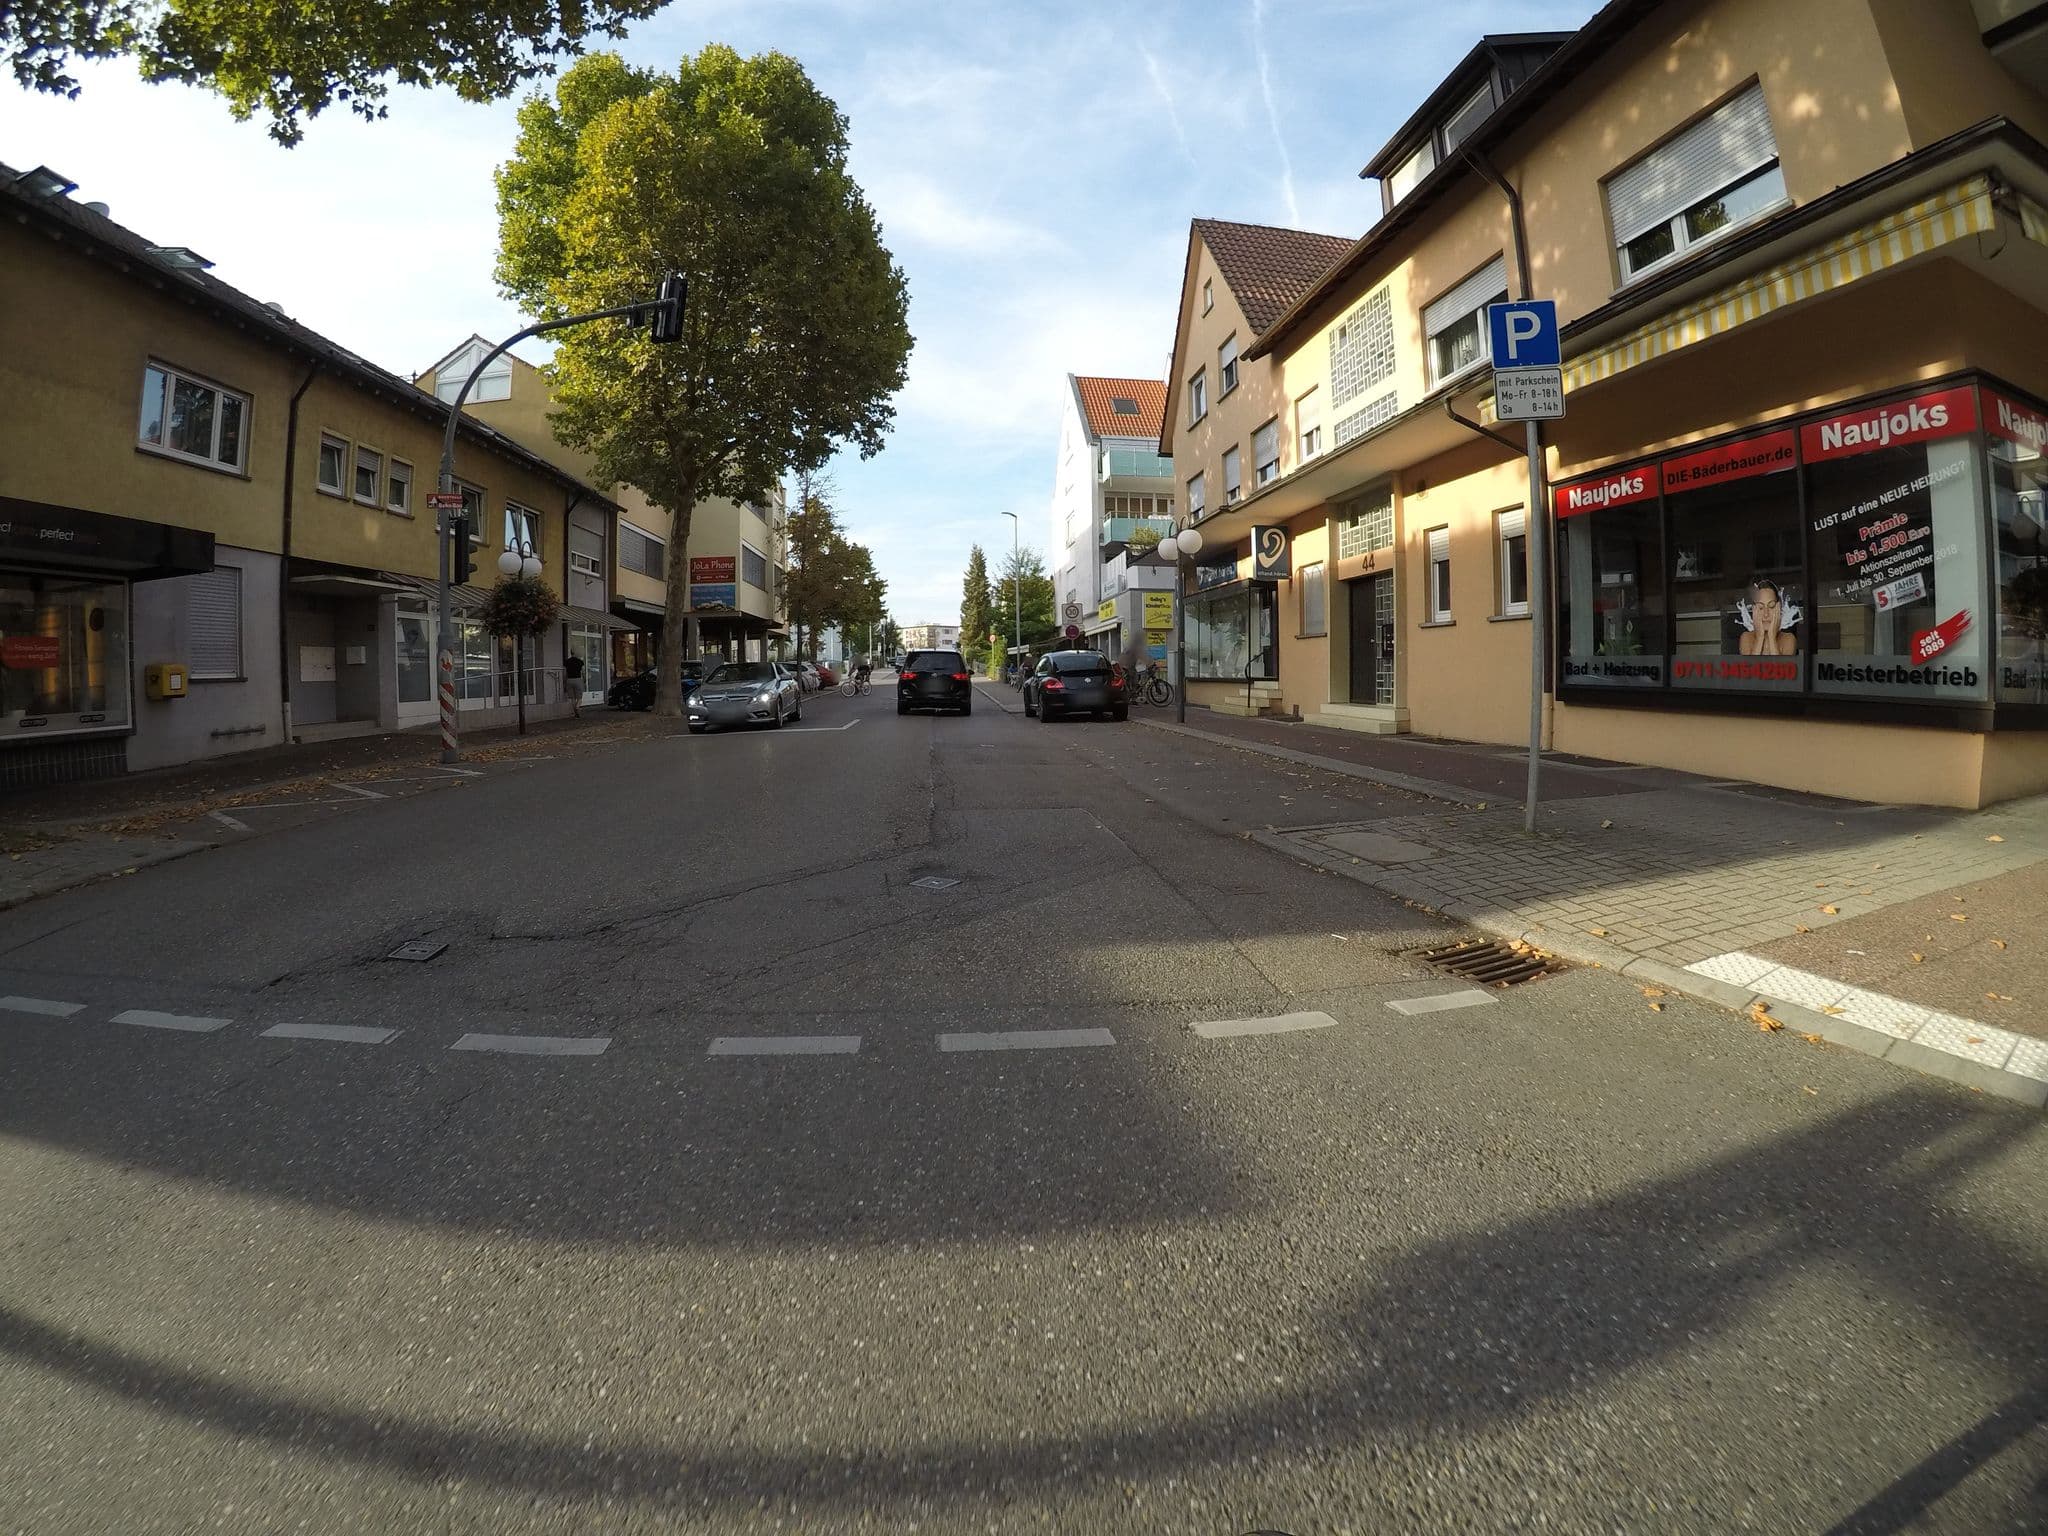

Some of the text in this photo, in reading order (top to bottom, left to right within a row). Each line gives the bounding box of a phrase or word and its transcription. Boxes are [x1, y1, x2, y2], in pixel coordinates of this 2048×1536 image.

[1505, 311, 1540, 359] P
[1499, 375, 1558, 387] mit Parkschein
[1502, 389, 1527, 400] Mo-Fr
[1503, 404, 1512, 414] Sa
[1821, 404, 1949, 450] Naujoks
[1997, 399, 2048, 449] Naujo
[1667, 447, 1793, 485] DIE-Bäderbauer.de
[1568, 476, 1644, 508] Naujoks
[1814, 460, 1965, 531] LUST auf eine NEUE HEIZUNG?
[40, 526, 74, 541] perfect
[1859, 512, 1908, 541] Prämie
[1362, 553, 1375, 571] 44
[1845, 550, 1867, 566] bis
[1869, 531, 1908, 556] 1.500
[1860, 544, 1925, 575] Aktionszeitraum
[711, 560, 734, 569] Phone
[1845, 581, 1859, 593] Juli
[1859, 577, 1872, 588] bis
[1873, 571, 1887, 583] 30.
[1887, 554, 1934, 578] September
[1935, 543, 1958, 560] 2018
[1877, 591, 1889, 608] 5
[1894, 575, 1919, 592] JAHRE
[1919, 630, 1940, 647] seit
[1919, 638, 1945, 657] 1989
[1565, 662, 1587, 676] Bad
[1604, 662, 1660, 680] Heizung
[1817, 663, 1978, 687] Meisterbetrieb
